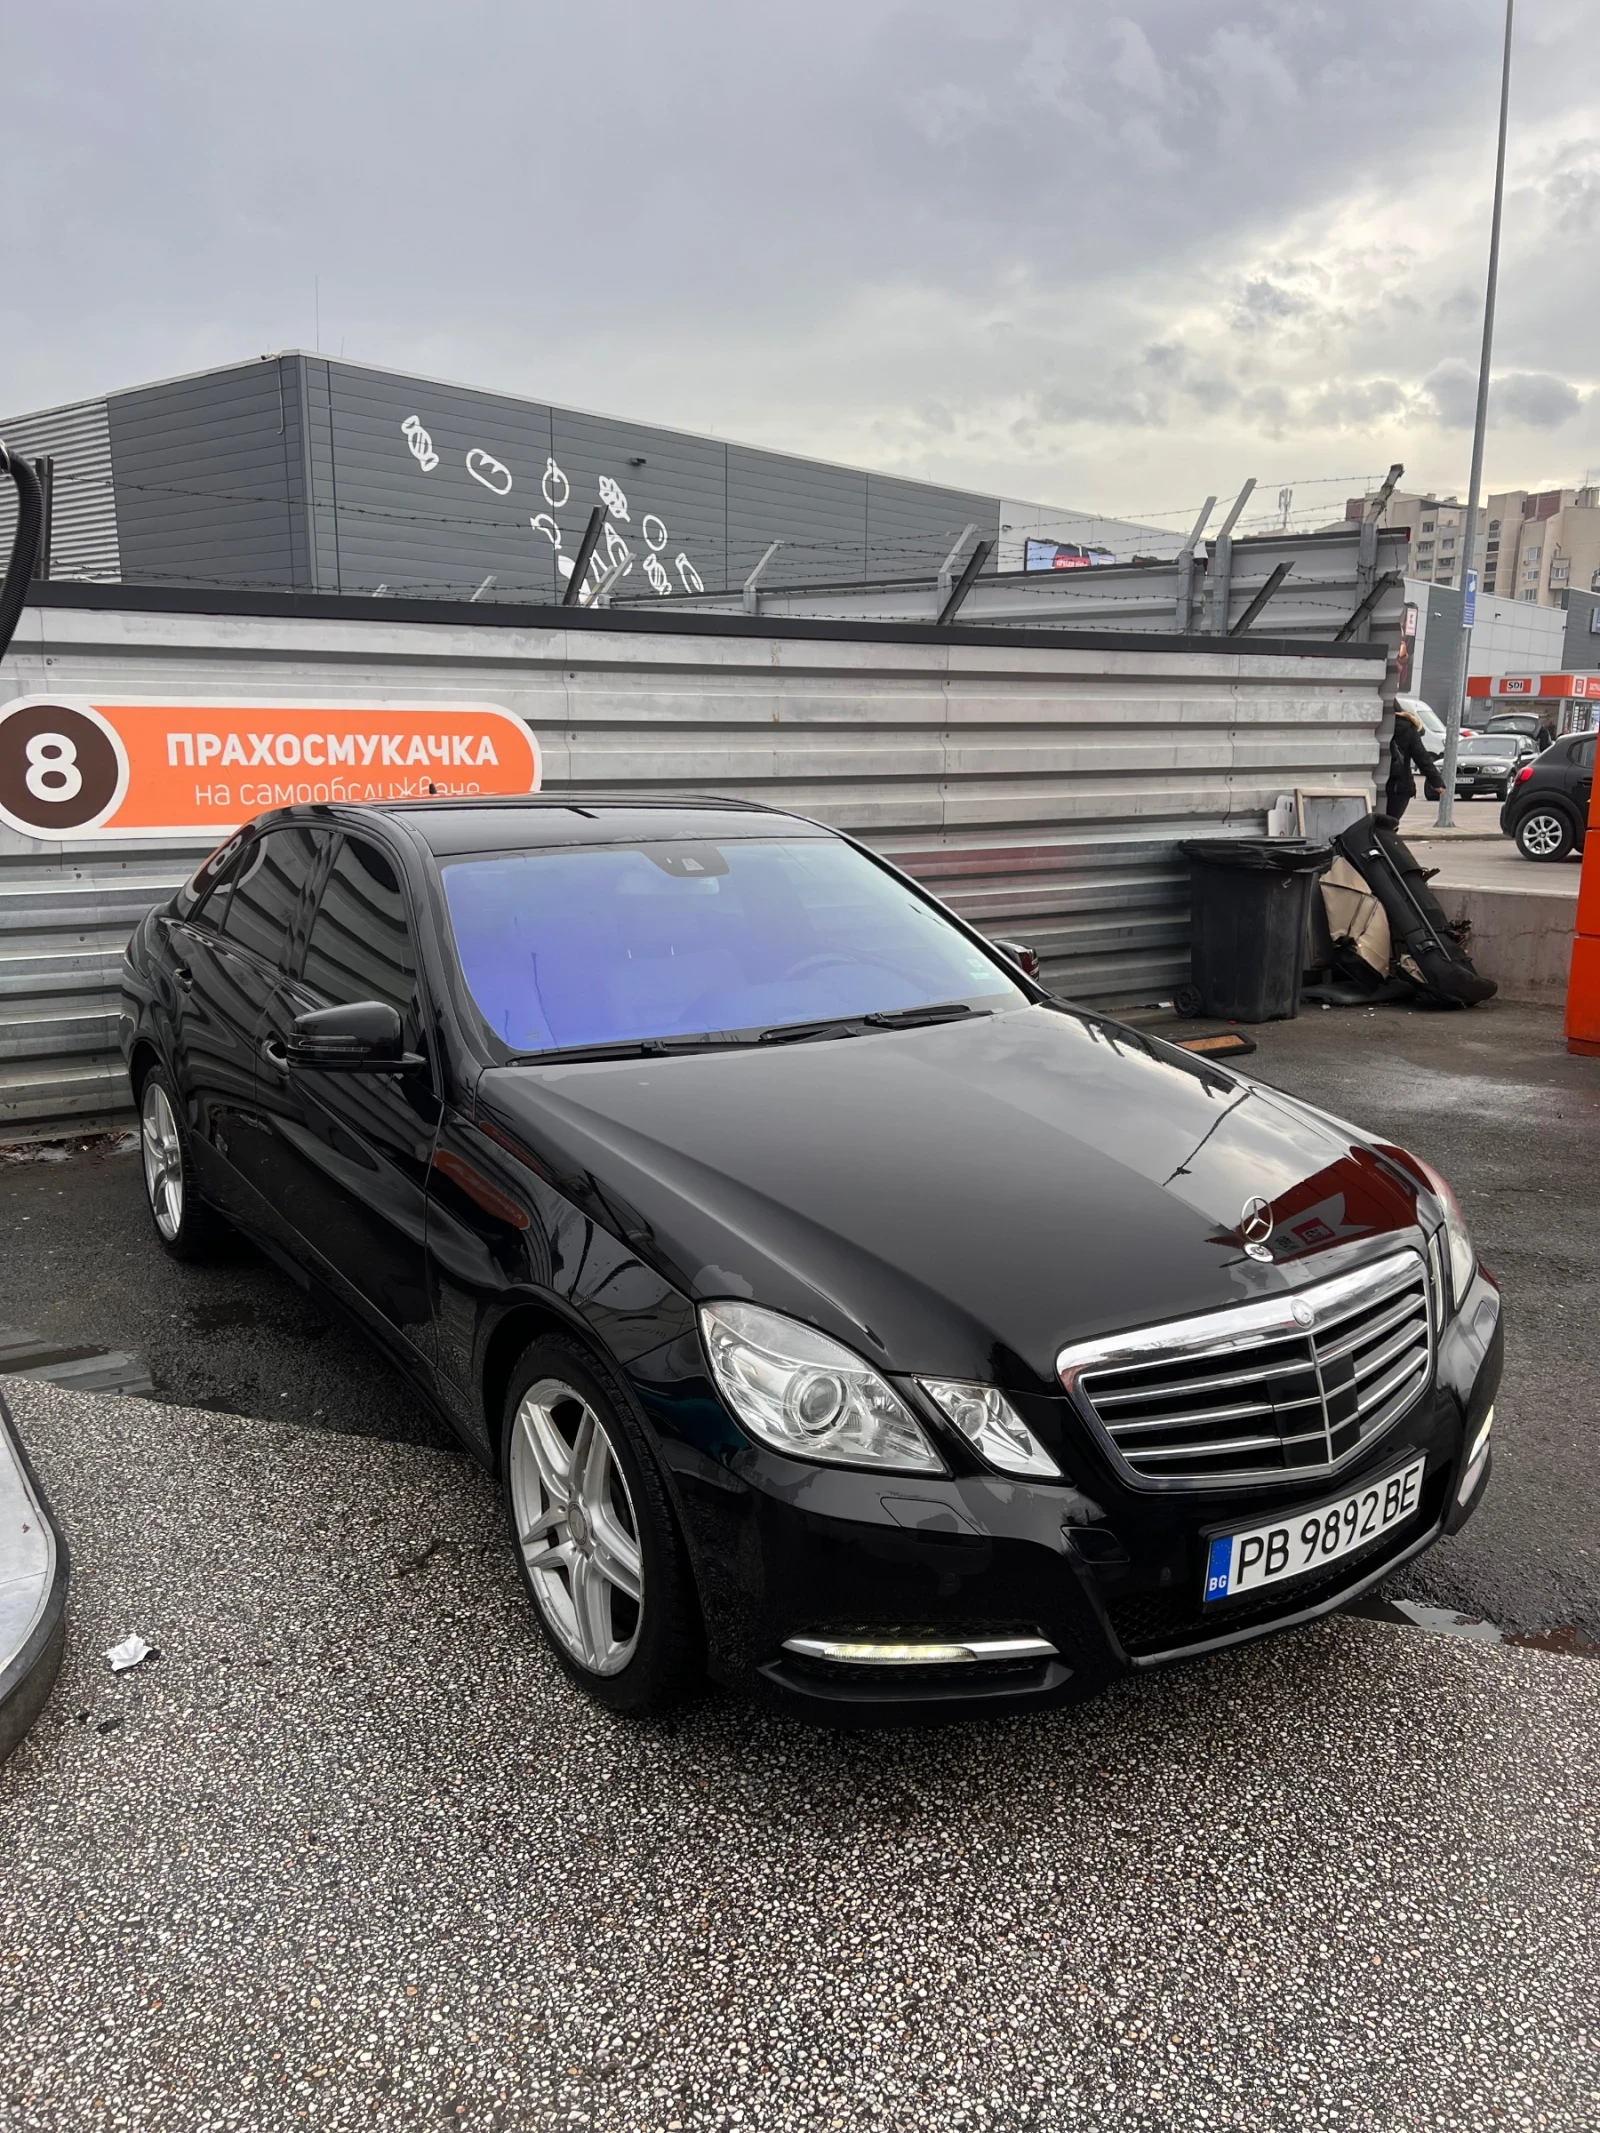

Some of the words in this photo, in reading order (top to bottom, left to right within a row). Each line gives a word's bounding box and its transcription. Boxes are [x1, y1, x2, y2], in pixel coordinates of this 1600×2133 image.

[1507, 681, 1523, 690] SDI
[166, 732, 499, 766] ПРАХОСМУКАЧКА
[25, 733, 83, 802] 8
[195, 784, 231, 806] на
[1237, 1528, 1290, 1585] PB
[1300, 1490, 1379, 1564] 9892
[1382, 1465, 1420, 1526] BE
[1208, 1575, 1228, 1592] BG
